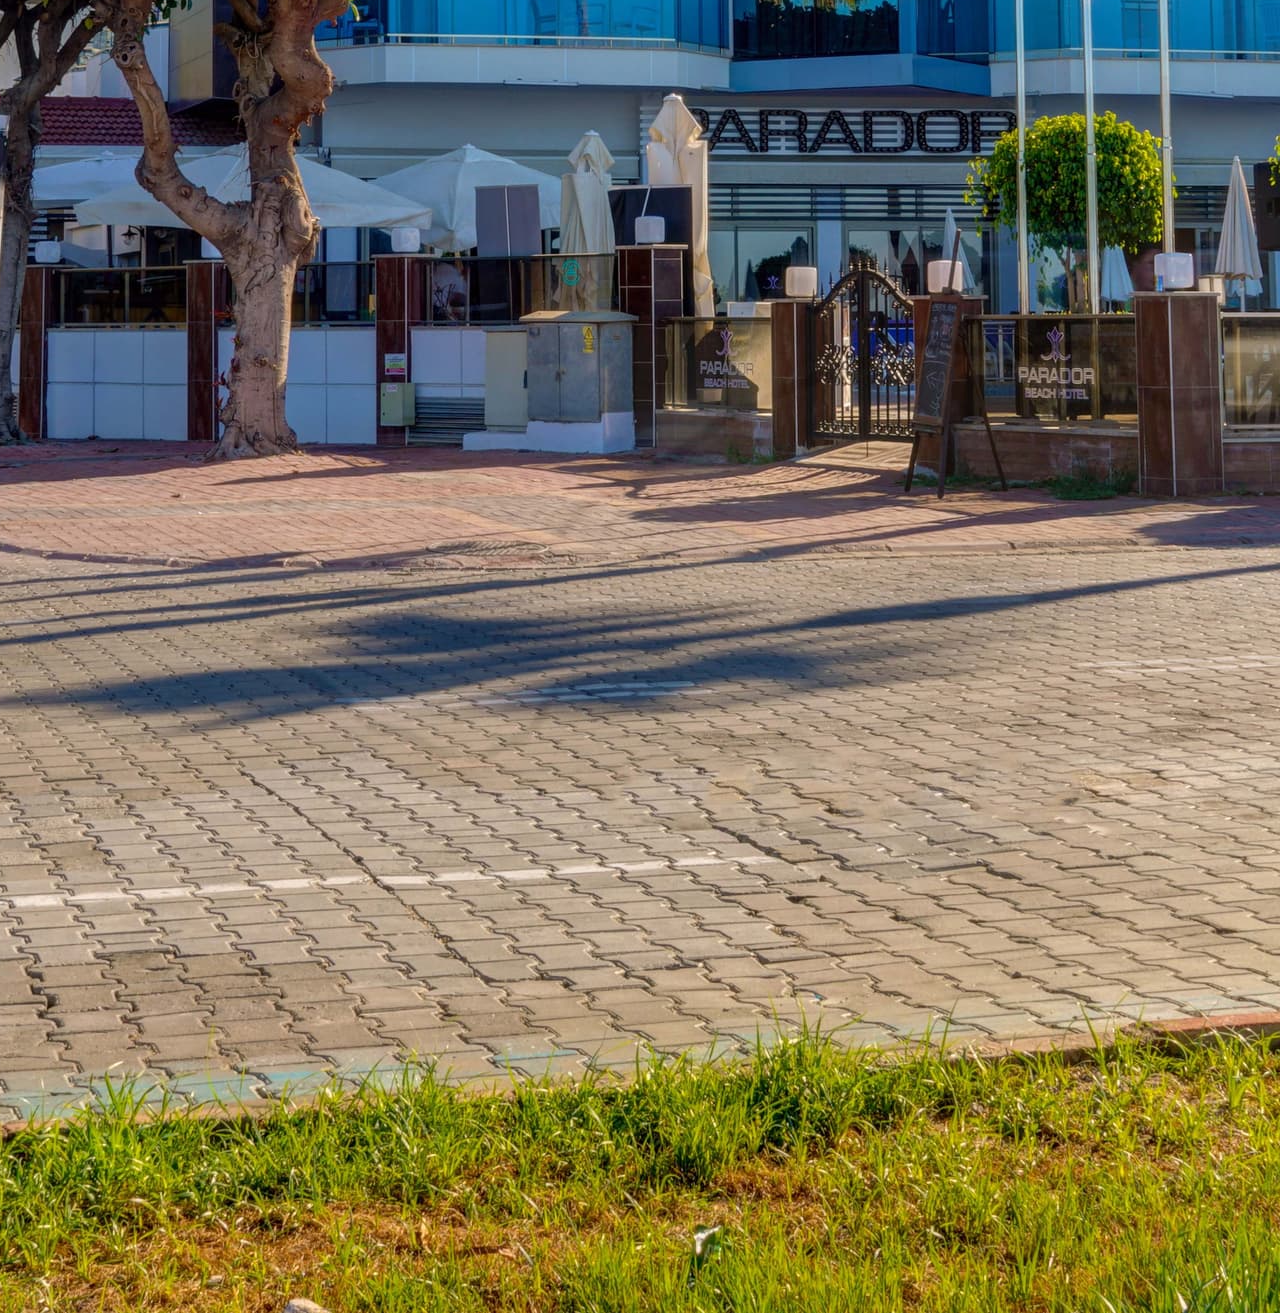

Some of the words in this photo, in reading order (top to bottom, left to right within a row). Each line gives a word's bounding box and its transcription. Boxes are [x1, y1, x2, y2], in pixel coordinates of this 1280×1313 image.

[1018, 367, 1095, 384] PARADOR
[704, 378, 726, 387] BEACH
[727, 379, 750, 389] HOTEL
[1024, 387, 1056, 399] BEACH
[1058, 388, 1089, 400] HOTEL
